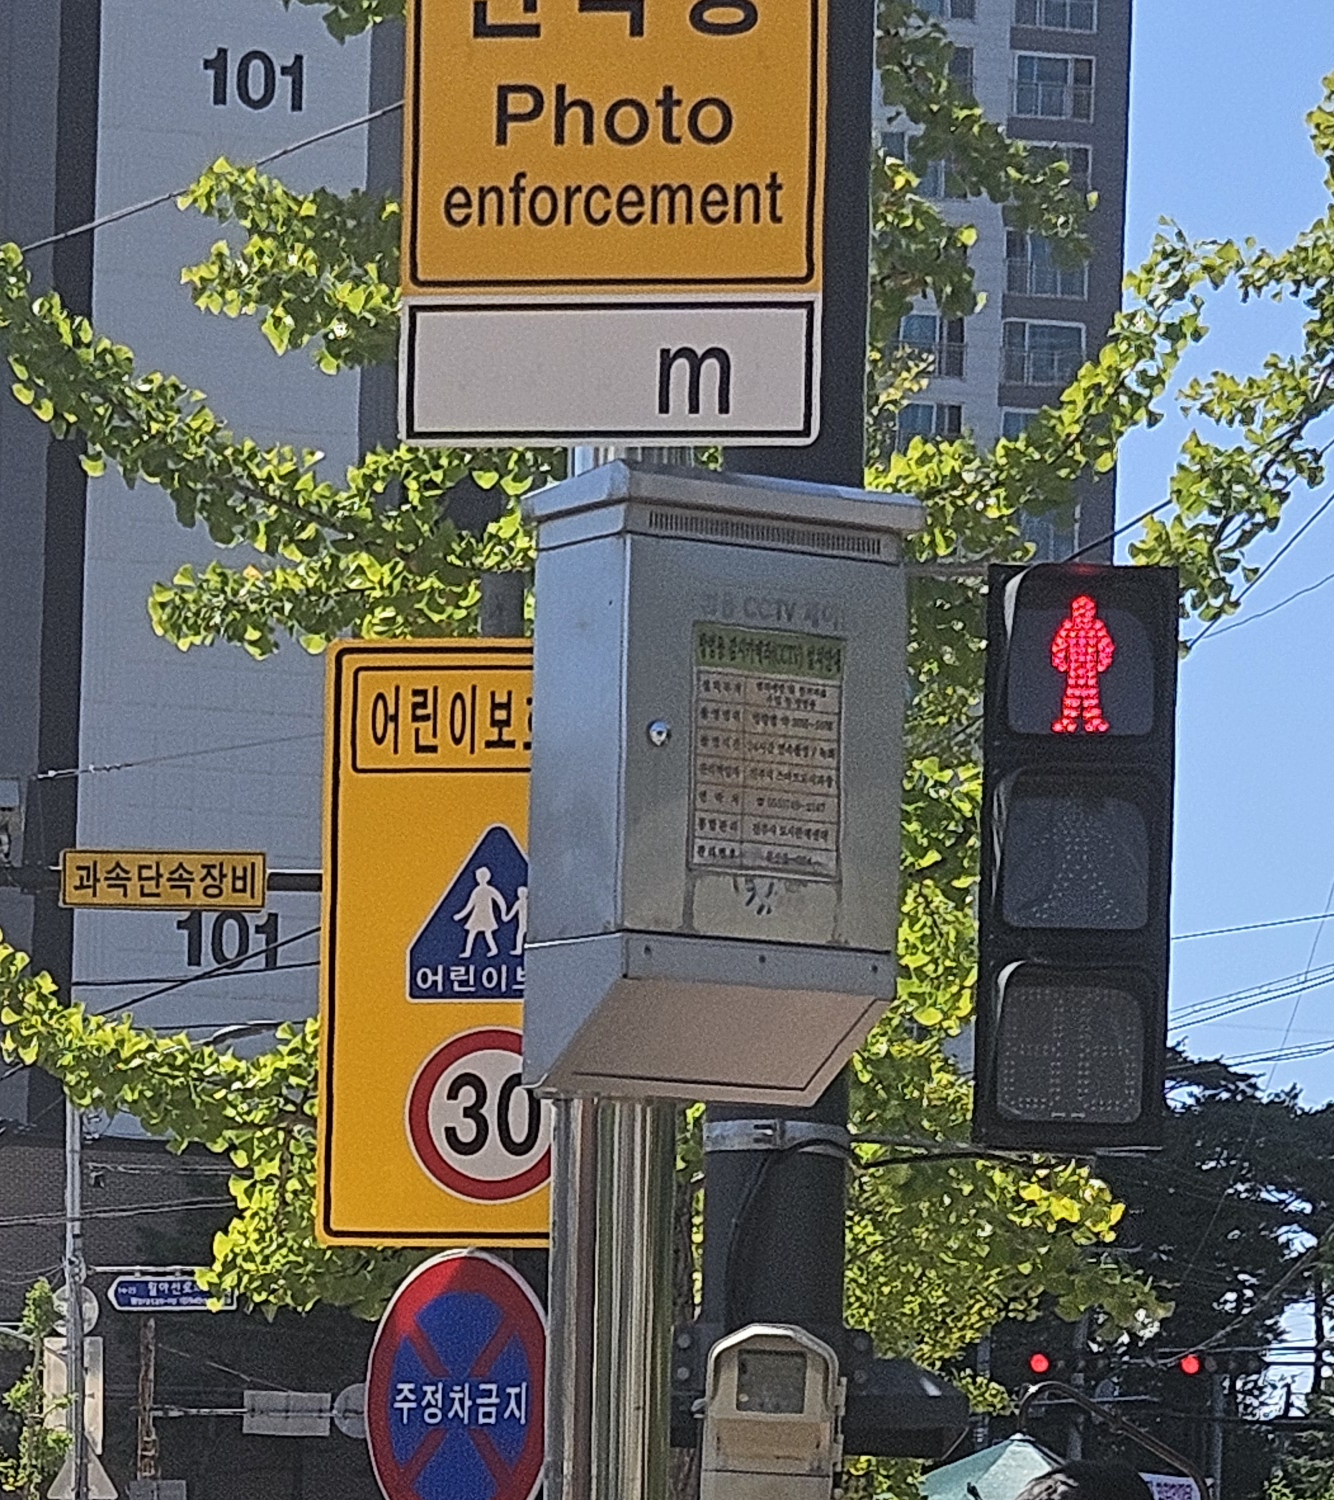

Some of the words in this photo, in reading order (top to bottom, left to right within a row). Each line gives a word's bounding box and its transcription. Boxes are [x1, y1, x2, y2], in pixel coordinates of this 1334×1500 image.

[203, 47, 304, 112] 101
[494, 83, 734, 147] Photo
[443, 172, 783, 228] enforcement
[657, 345, 731, 415] m
[72, 860, 257, 900] 과속단속장비
[176, 910, 280, 971] 101
[444, 1072, 542, 1157] 30
[393, 1381, 527, 1425] 주정차금지
